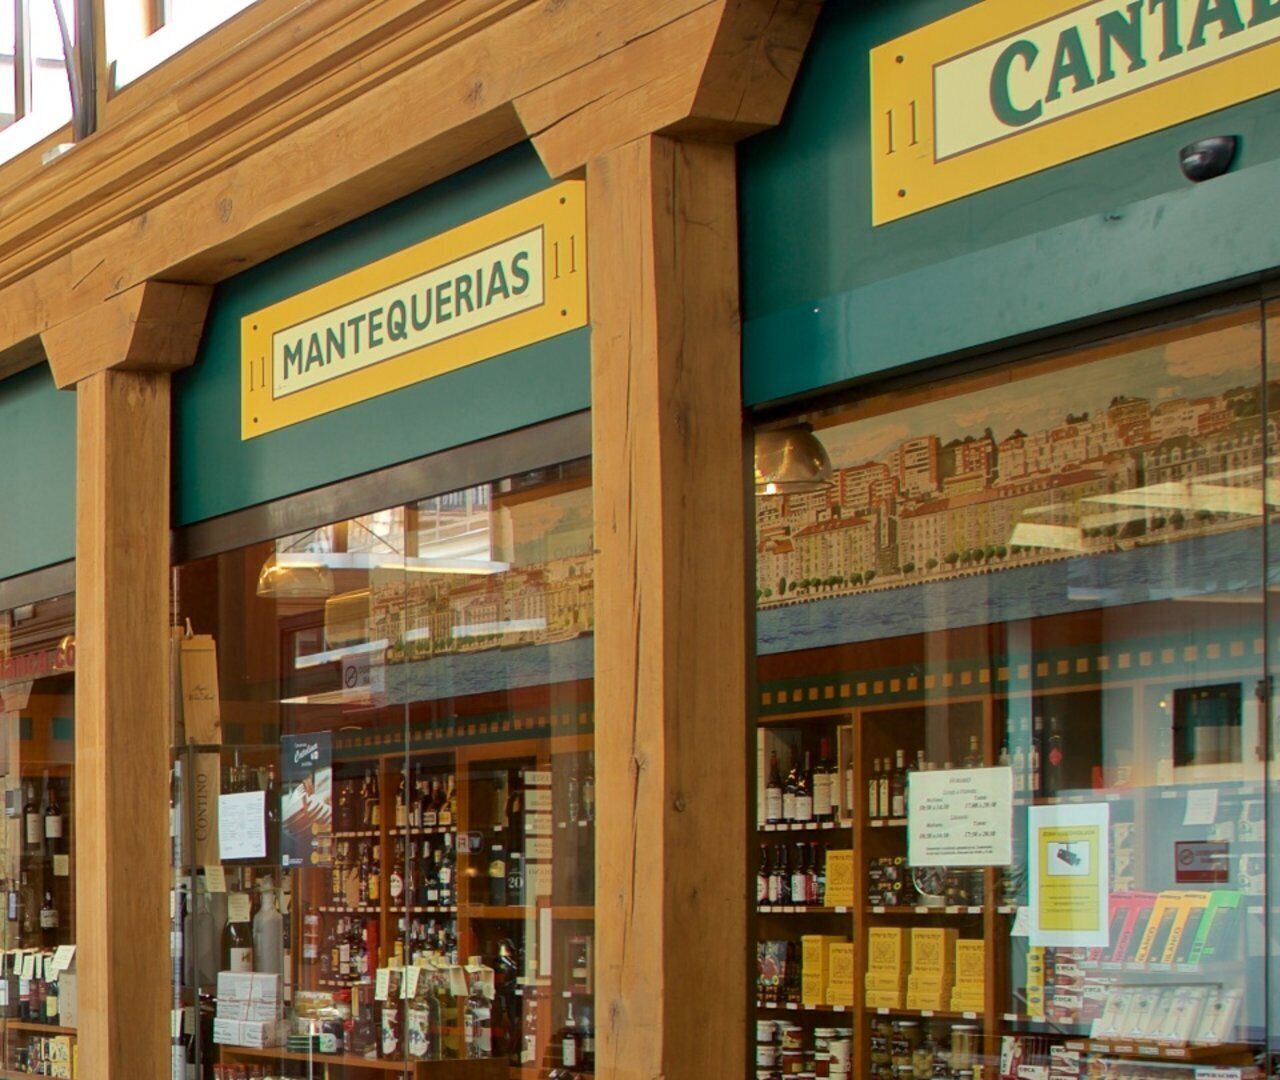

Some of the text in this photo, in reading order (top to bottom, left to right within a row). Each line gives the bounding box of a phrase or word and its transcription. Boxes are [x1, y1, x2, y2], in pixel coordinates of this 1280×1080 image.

[885, 100, 918, 155] 11
[553, 235, 577, 279] 11
[282, 250, 529, 380] MANTEQUERIAS
[249, 356, 266, 392] 11
[508, 876, 523, 888] 20
